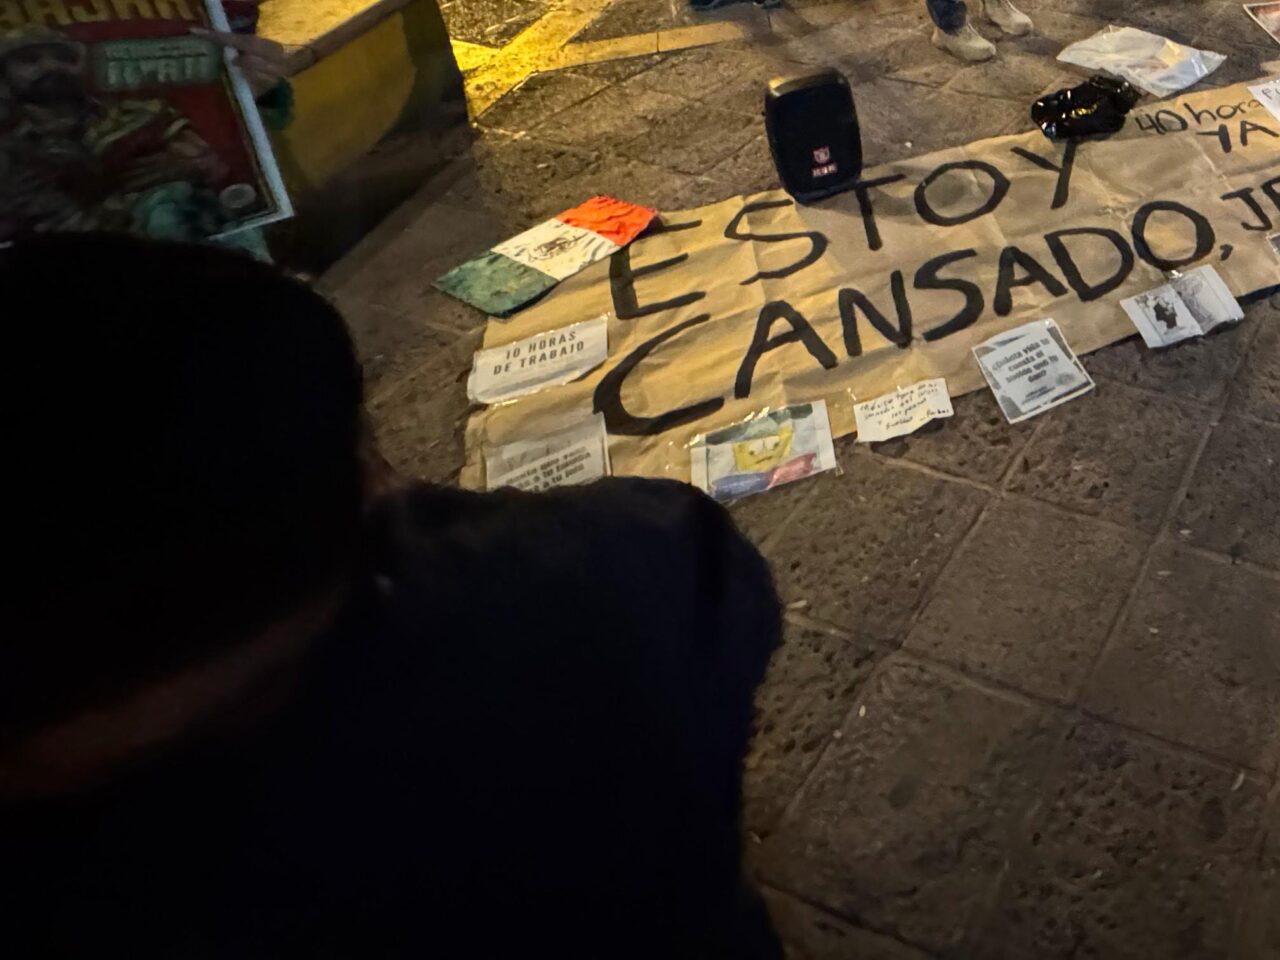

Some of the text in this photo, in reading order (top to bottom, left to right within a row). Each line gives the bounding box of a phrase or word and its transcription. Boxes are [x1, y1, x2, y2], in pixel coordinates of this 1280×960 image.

[1135, 110, 1188, 135] 40
[1196, 120, 1280, 153] YA
[609, 141, 1077, 320] ESTOY
[528, 331, 577, 353] HORAS
[493, 360, 512, 375] DE
